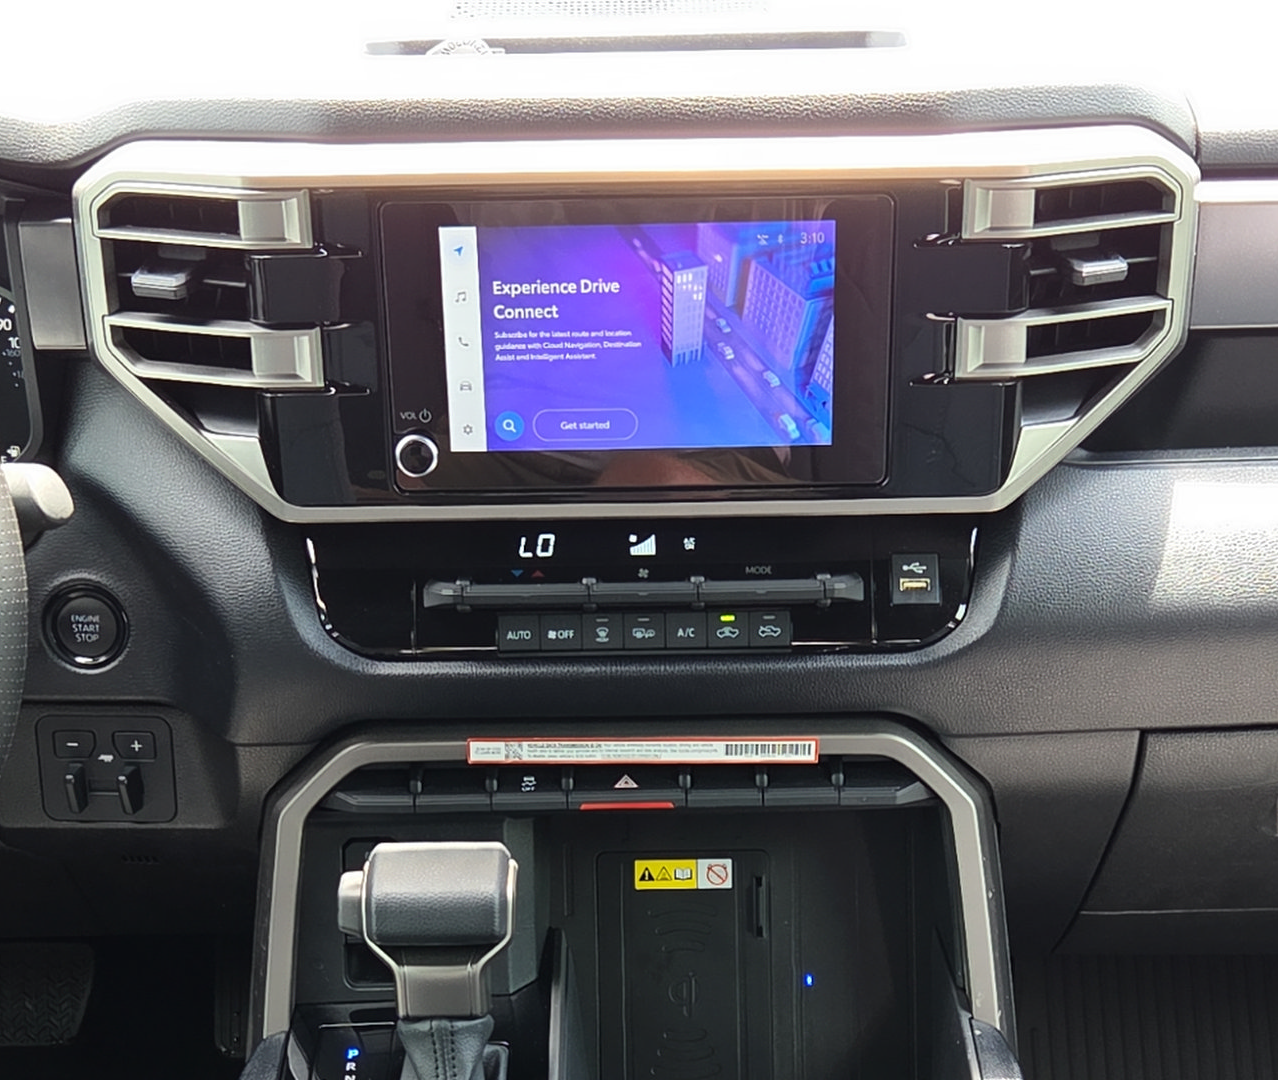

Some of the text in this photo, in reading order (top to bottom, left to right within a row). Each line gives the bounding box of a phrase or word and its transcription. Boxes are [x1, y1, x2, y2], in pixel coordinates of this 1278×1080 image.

[800, 231, 826, 245] 3:10
[492, 278, 620, 298] Experience Drive
[493, 304, 559, 319] Connect
[494, 331, 528, 339] Subscribe
[529, 330, 538, 338] for
[539, 330, 550, 338] the
[551, 330, 570, 338] latest
[590, 330, 604, 338] and
[527, 342, 542, 350] with
[543, 341, 564, 349] Cloud
[603, 340, 642, 348] Destination
[495, 353, 515, 361] Assist
[516, 353, 529, 361] and
[560, 420, 610, 430] Get started
[72, 623, 100, 633] START
[677, 627, 695, 638] A/C
[74, 632, 100, 643] STOP
[506, 629, 531, 640] AUTO
[557, 628, 575, 640] OFF
[346, 1048, 360, 1060] P
[345, 1061, 357, 1071] R
